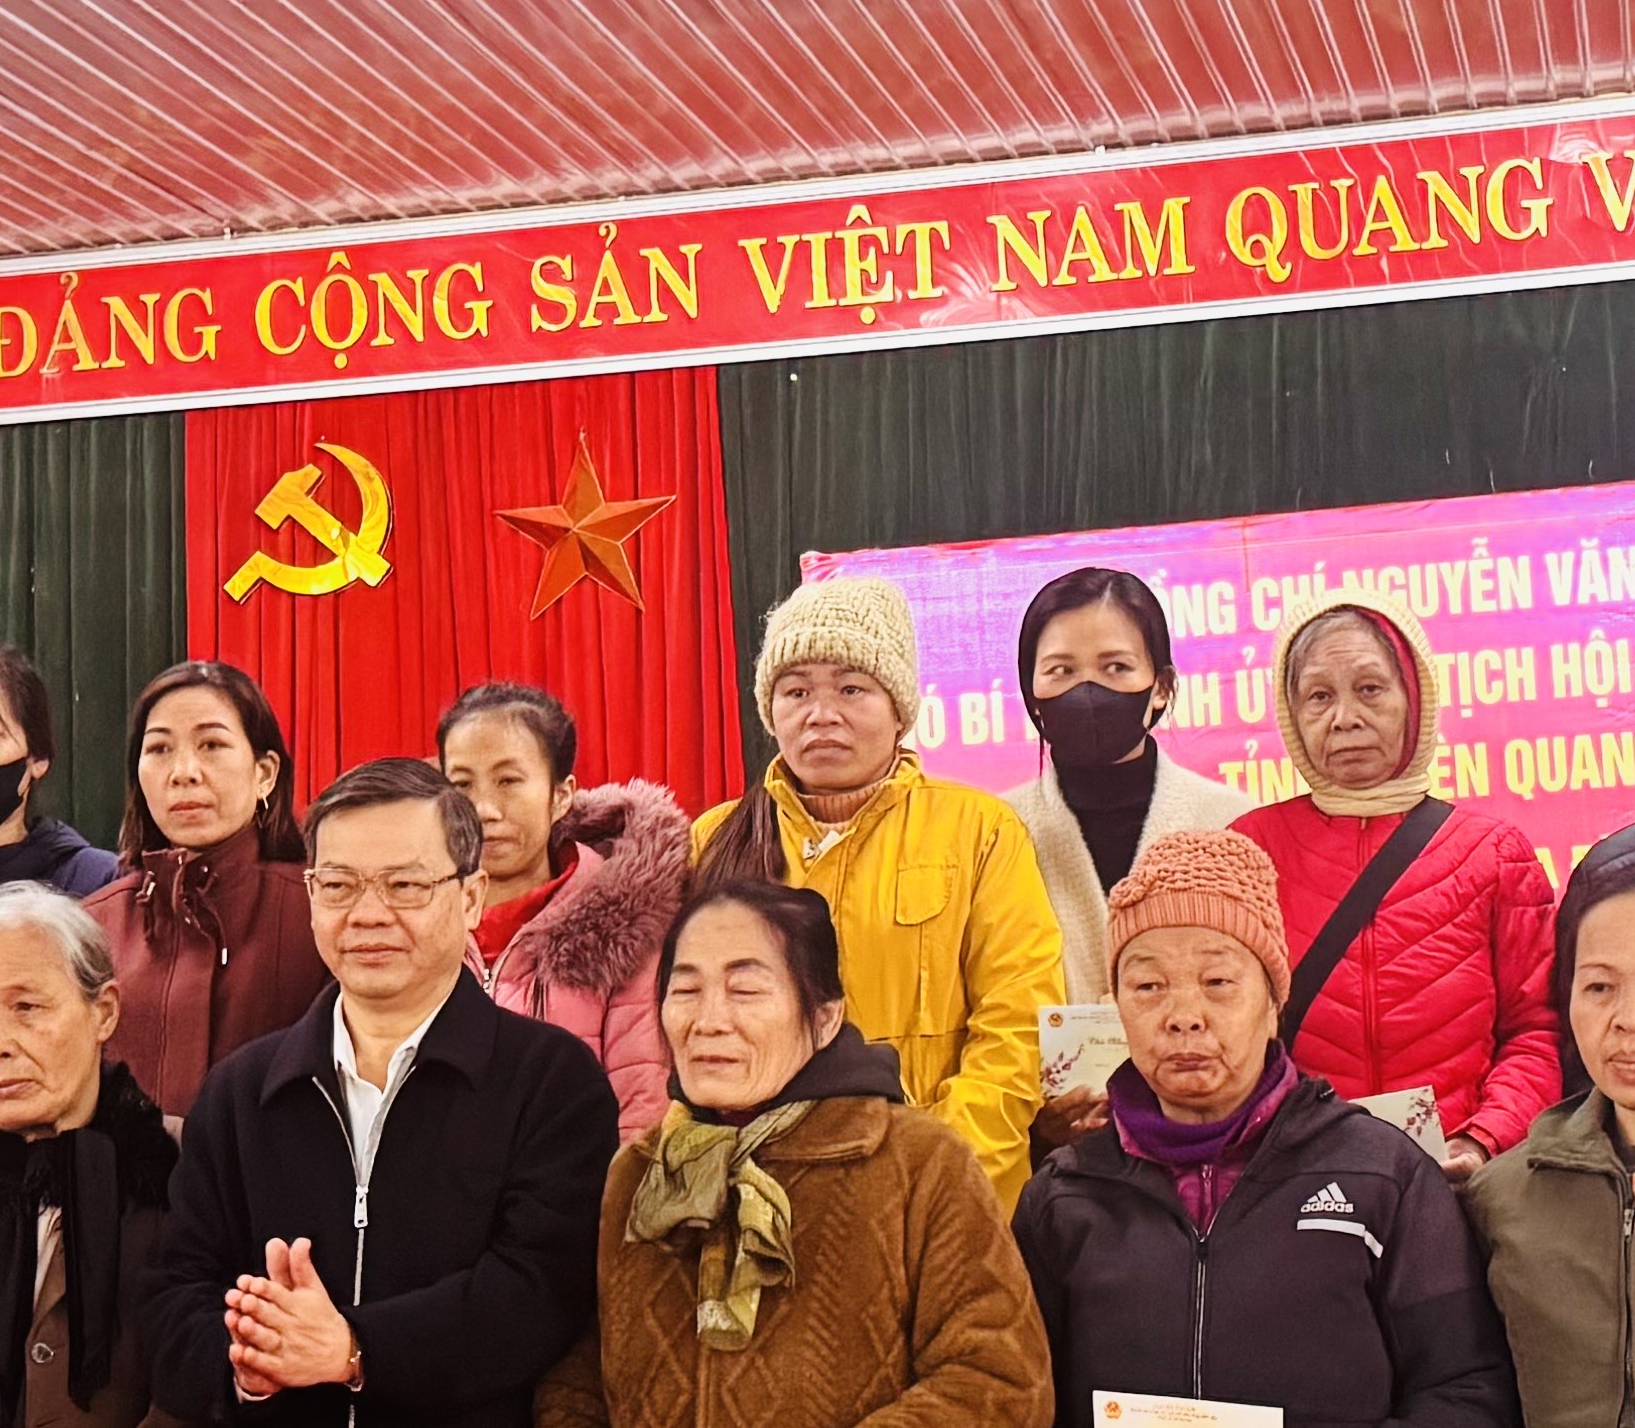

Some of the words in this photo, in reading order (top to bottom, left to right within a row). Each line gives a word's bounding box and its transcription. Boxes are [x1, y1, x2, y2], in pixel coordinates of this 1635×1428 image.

[255, 251, 493, 368] CỘNG
[530, 222, 704, 334] SẢN
[738, 204, 950, 325] VIỆT
[986, 196, 1196, 294] NAM
[1224, 155, 1555, 283] QUANG
[960, 679, 1005, 746] BÍ
[1433, 646, 1537, 719] TỊCH
[1550, 628, 1633, 709] HỘI
[1300, 1199, 1354, 1213] adidas
